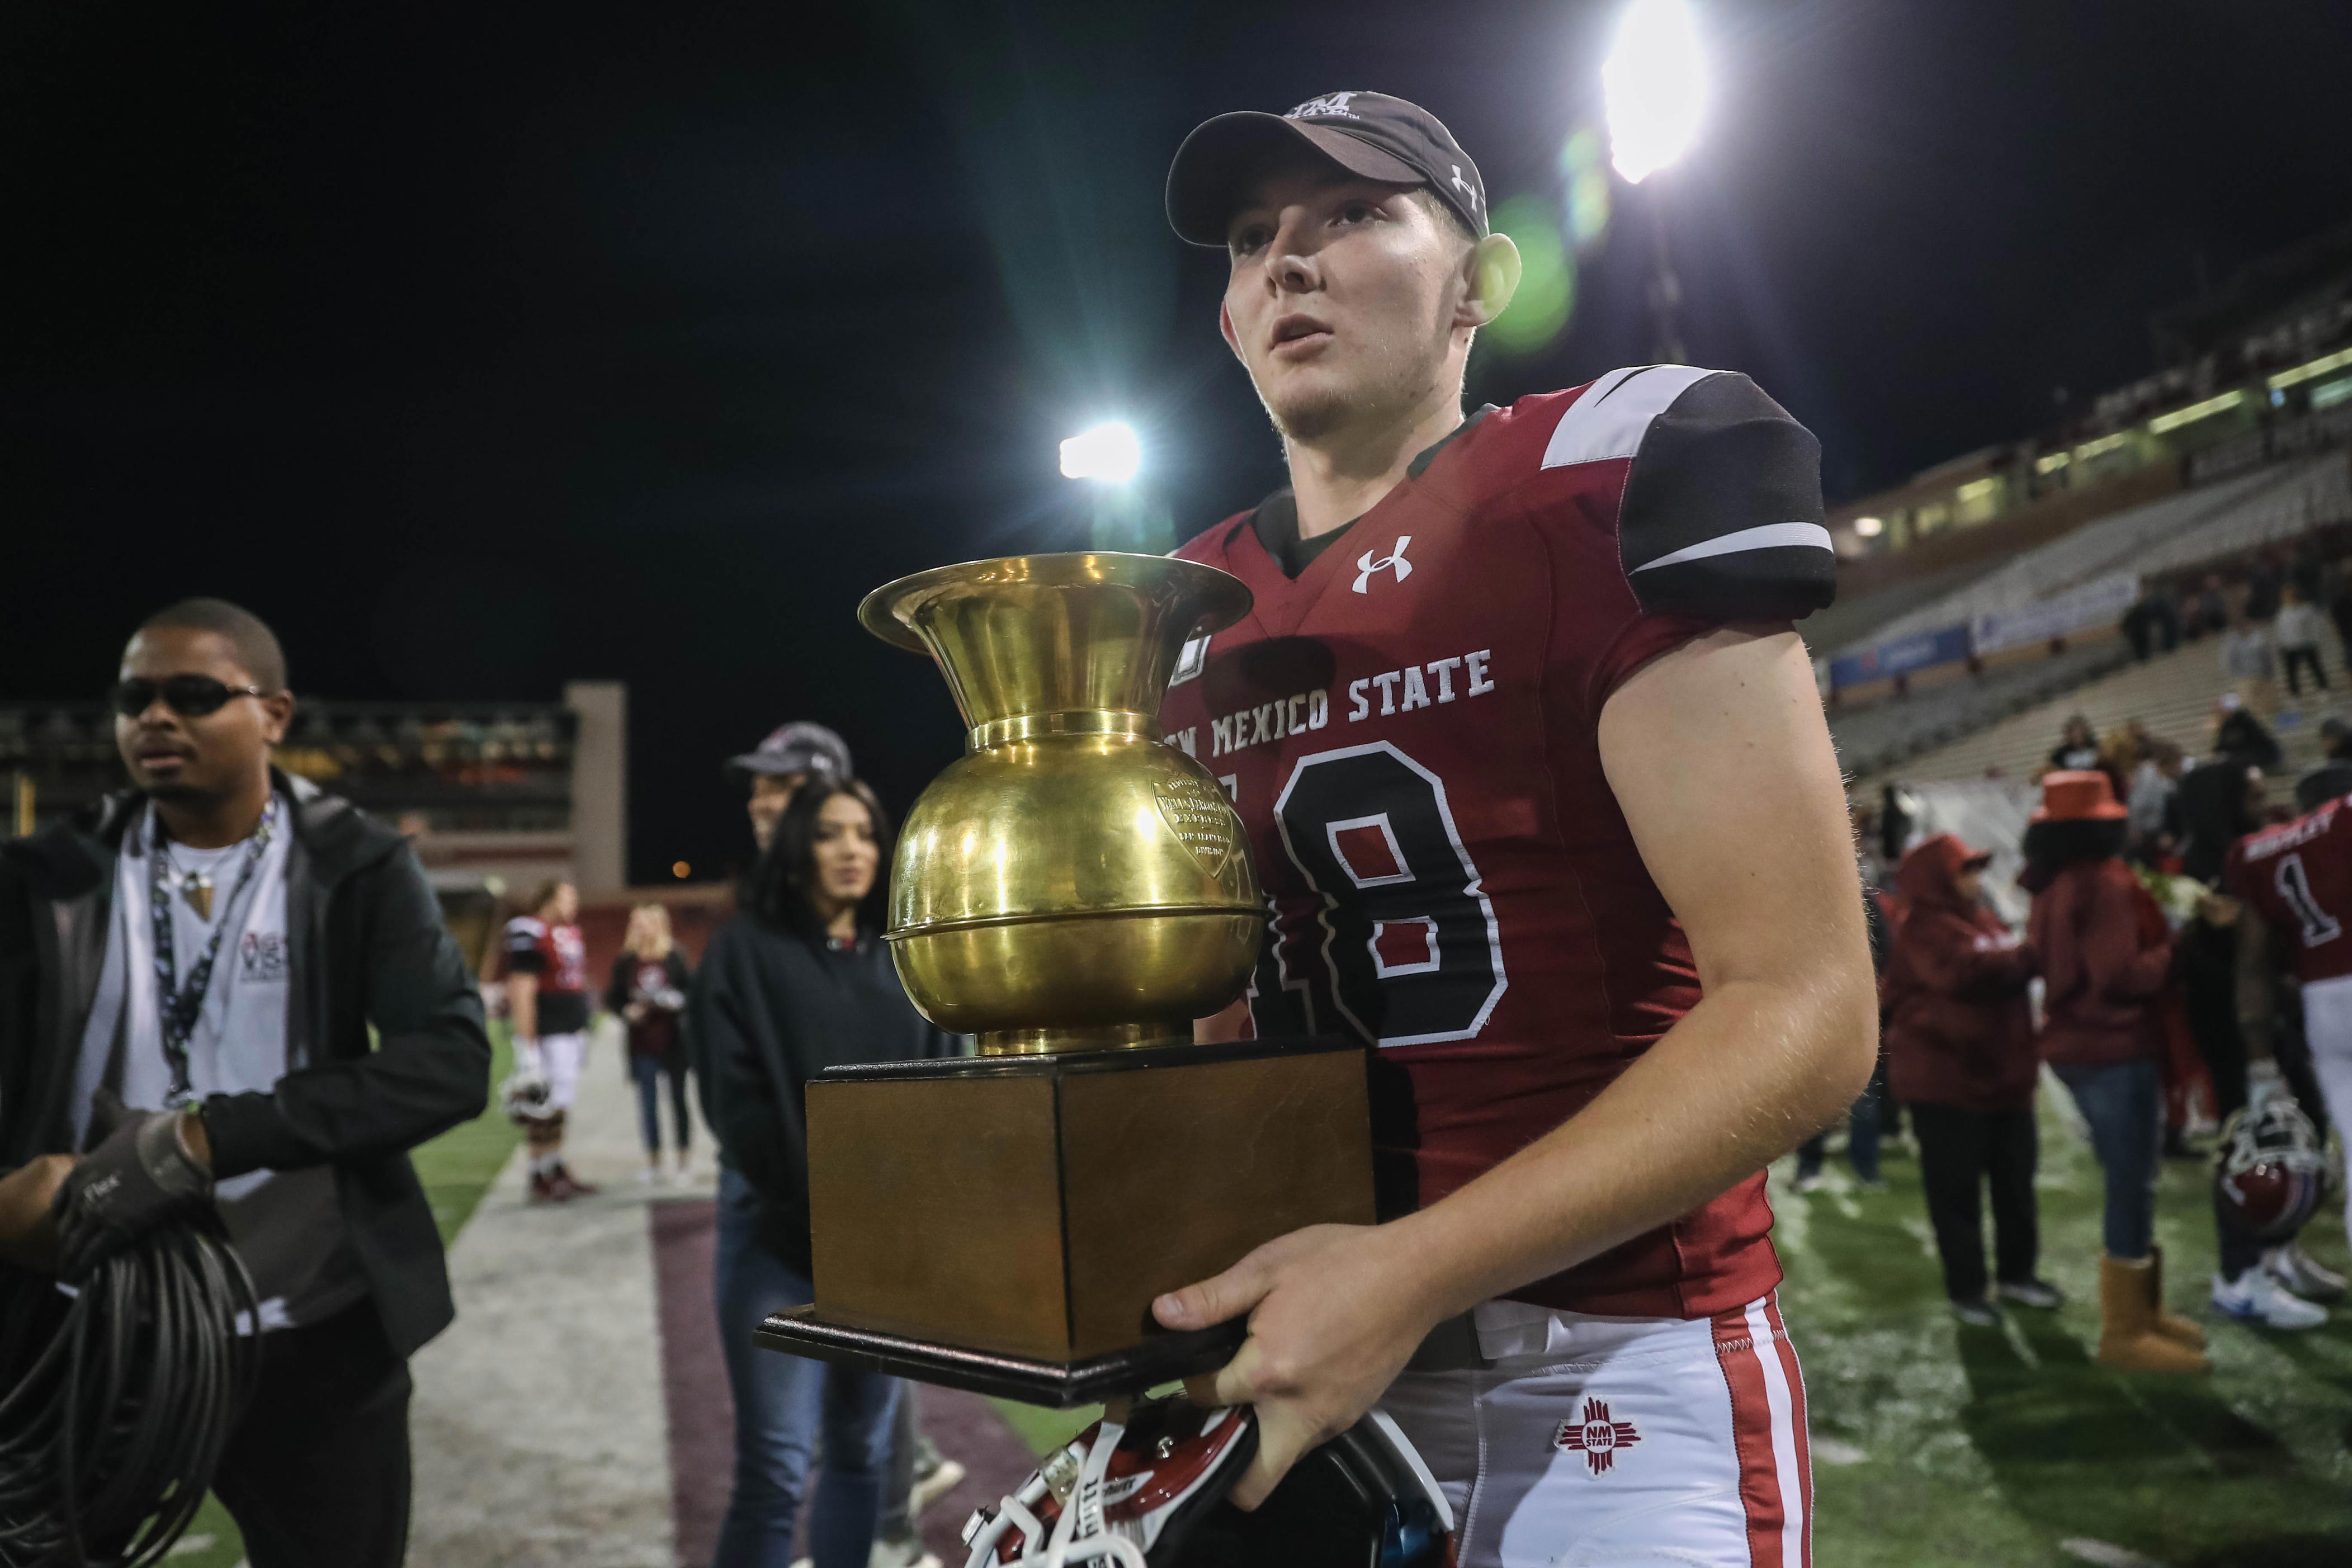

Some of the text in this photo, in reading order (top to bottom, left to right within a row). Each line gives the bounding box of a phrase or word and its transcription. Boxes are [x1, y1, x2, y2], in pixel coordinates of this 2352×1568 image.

[1211, 688, 1328, 757] MEXICO
[1348, 649, 1495, 722] STATE
[2274, 851, 2342, 948] 1
[1586, 1425, 1612, 1439] NM
[1586, 1438, 1613, 1447] STATE
